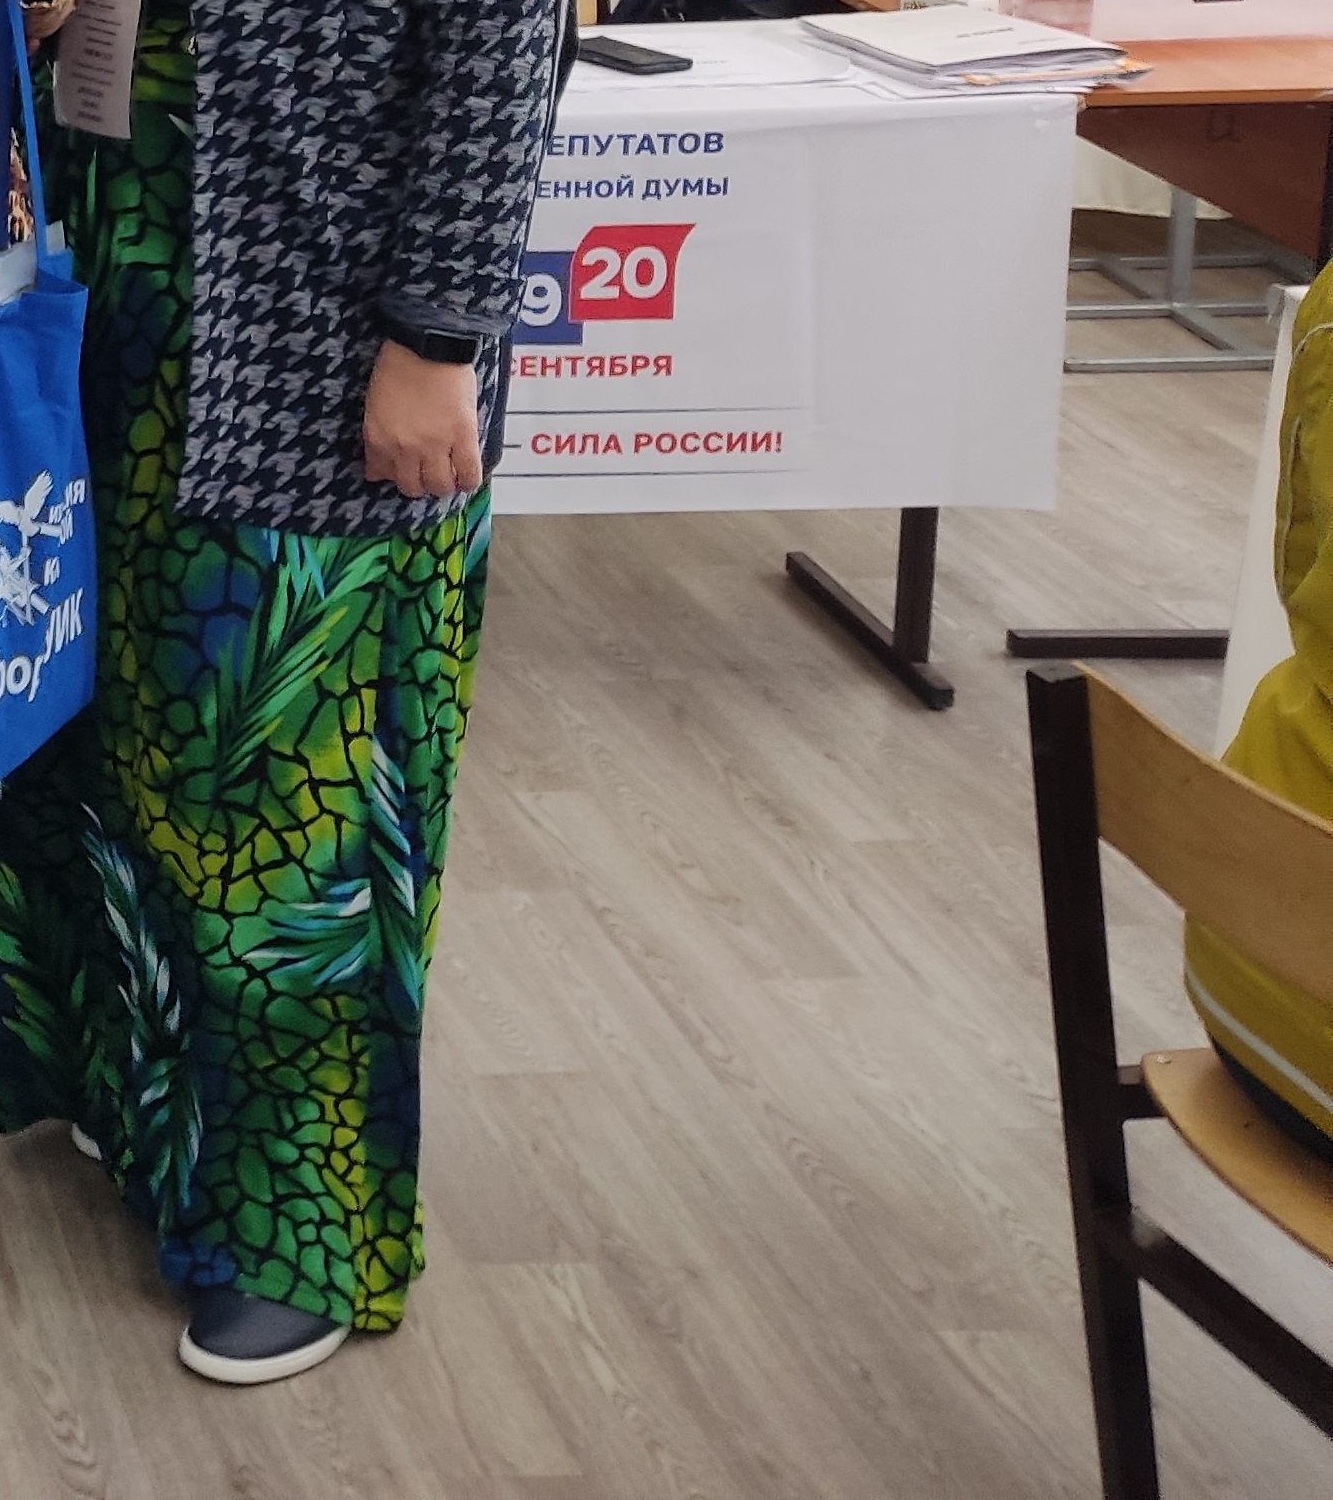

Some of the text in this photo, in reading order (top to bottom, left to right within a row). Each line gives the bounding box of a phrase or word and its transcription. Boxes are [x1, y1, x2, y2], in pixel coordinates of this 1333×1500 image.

[545, 132, 725, 156] ЕПУТАТОВ
[536, 173, 729, 200] ЕННОЙ ДУМЫ
[519, 246, 668, 327] 9 20
[530, 433, 624, 455] СИЛА
[632, 431, 783, 456] РОССИИ!
